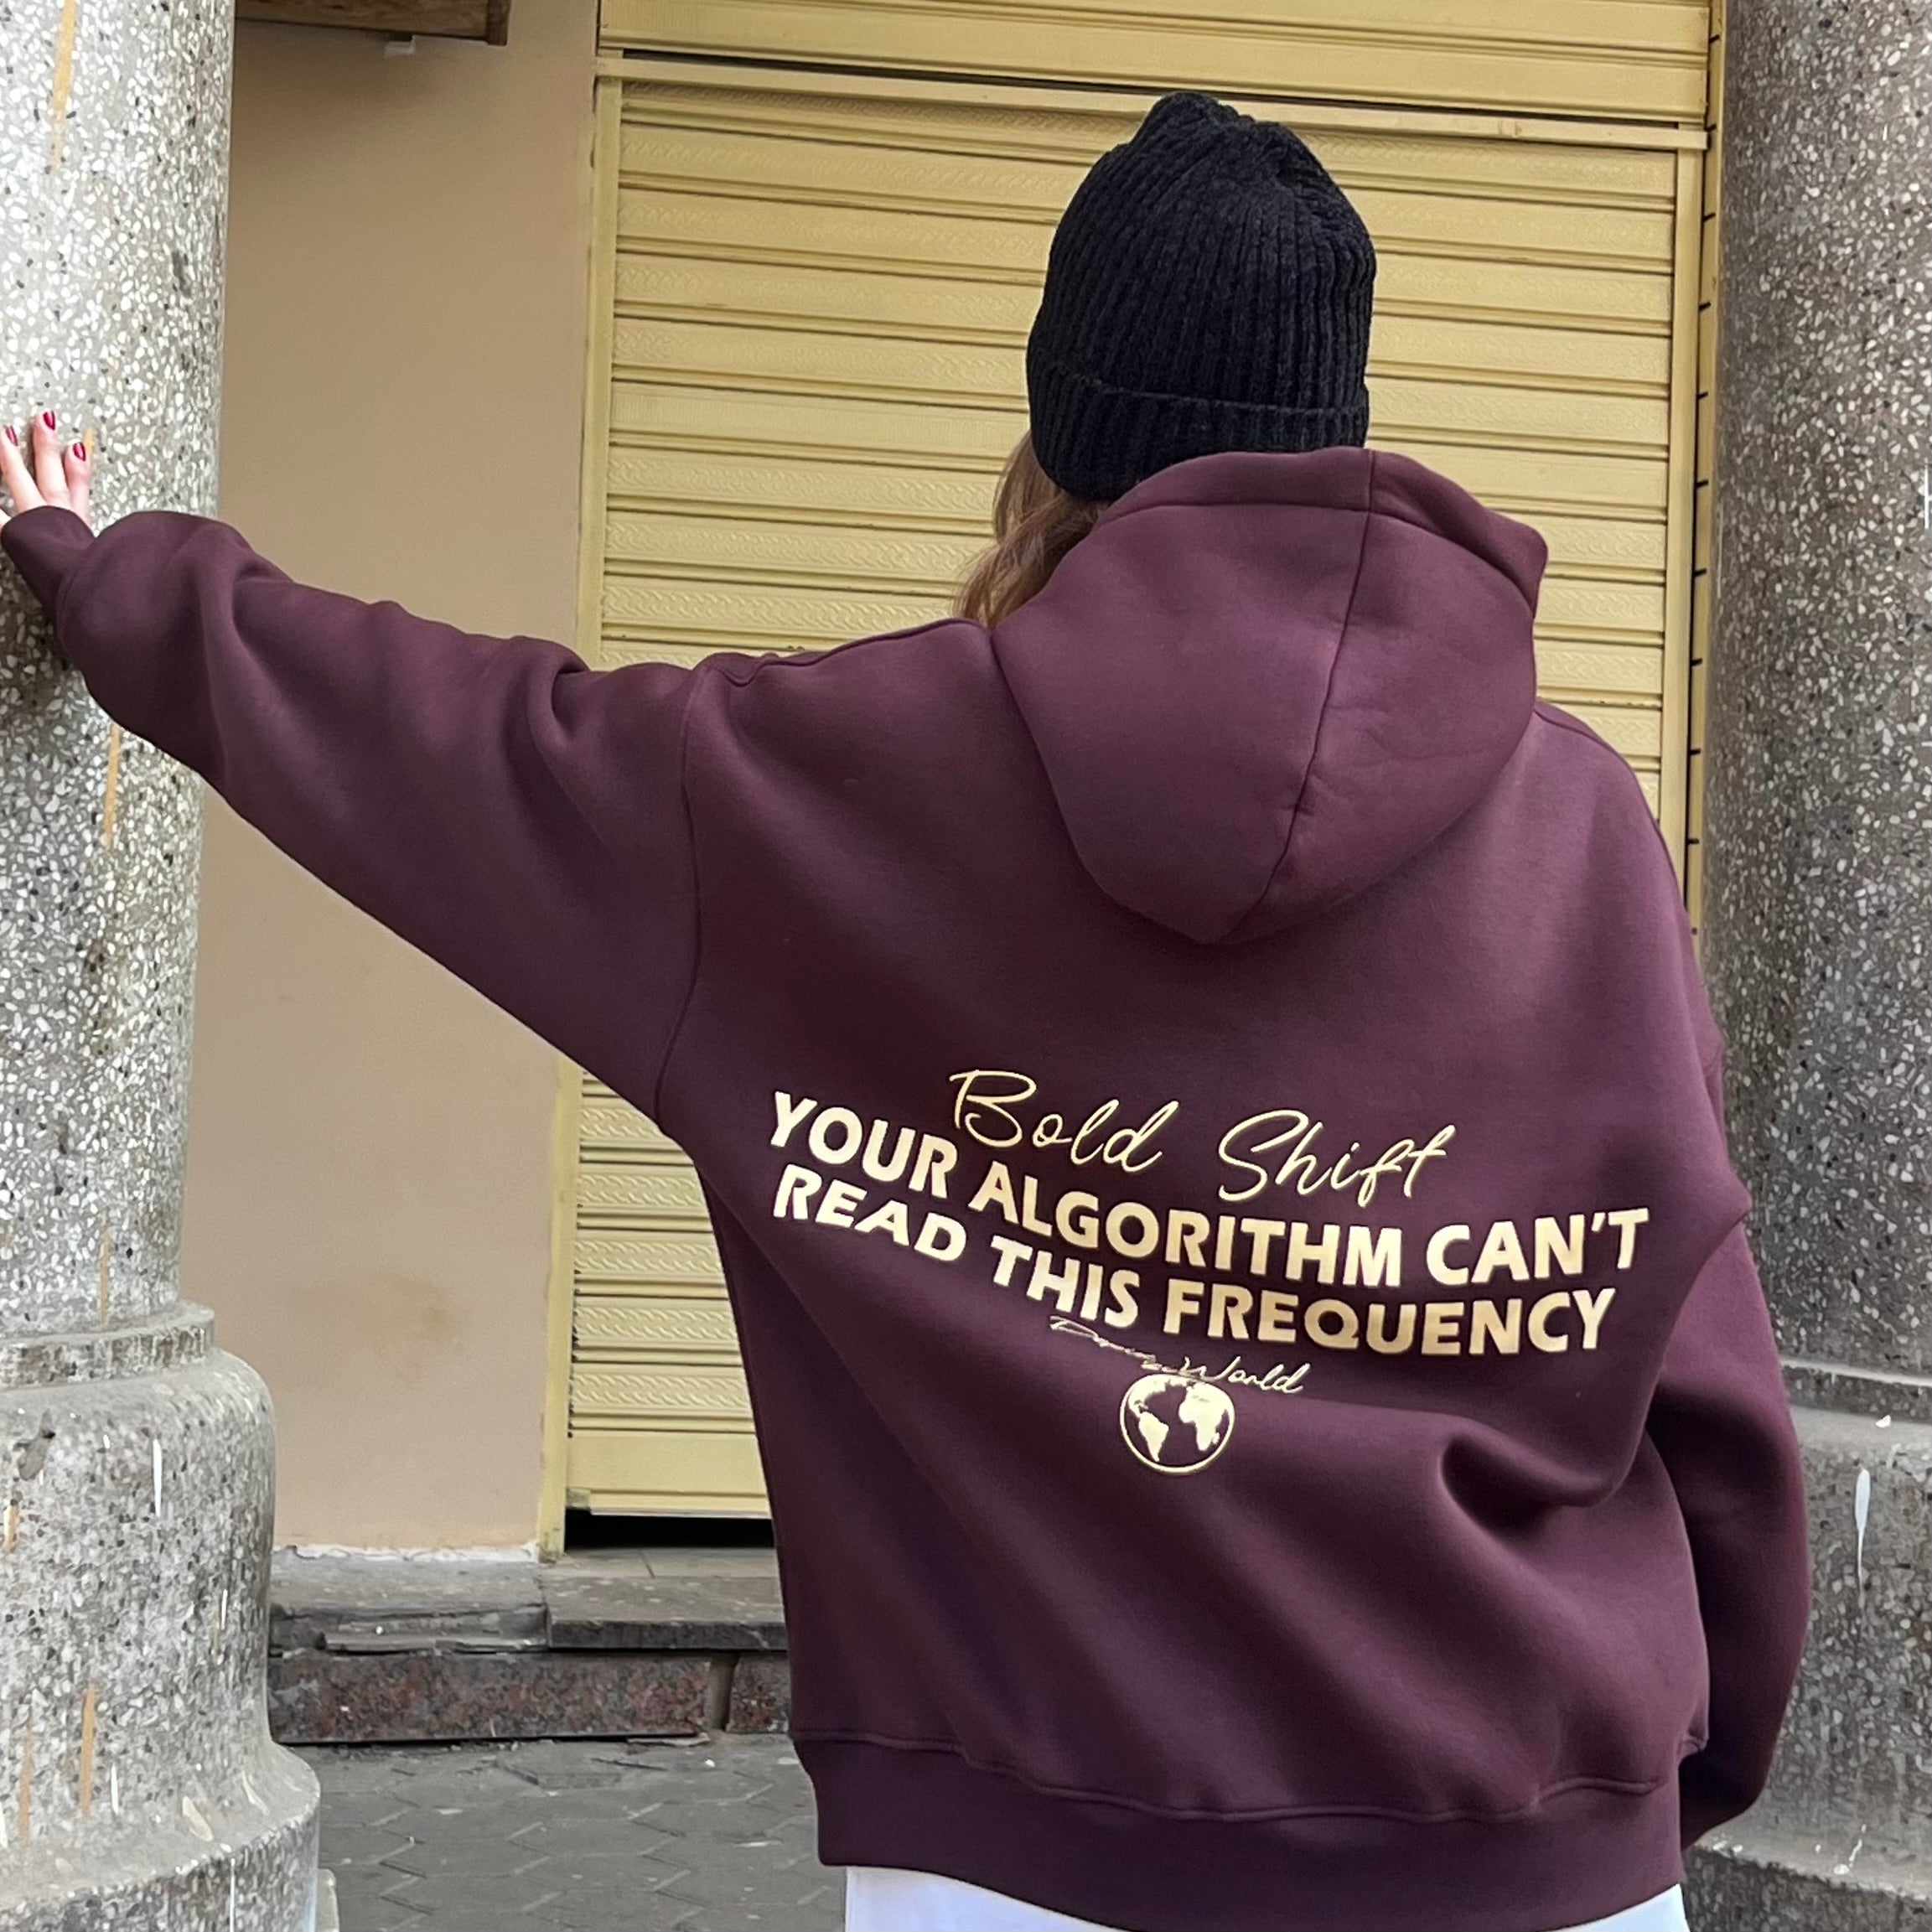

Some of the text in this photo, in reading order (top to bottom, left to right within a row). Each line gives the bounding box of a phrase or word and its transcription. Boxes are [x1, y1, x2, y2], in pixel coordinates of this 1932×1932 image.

[770, 1090, 1649, 1287] YOUR ALGORITHM CAN'T
[949, 1069, 1456, 1208] Bold Shift
[773, 1163, 966, 1261] READ
[990, 1235, 1140, 1329] THIS
[1163, 1278, 1616, 1354] FREQUENCY
